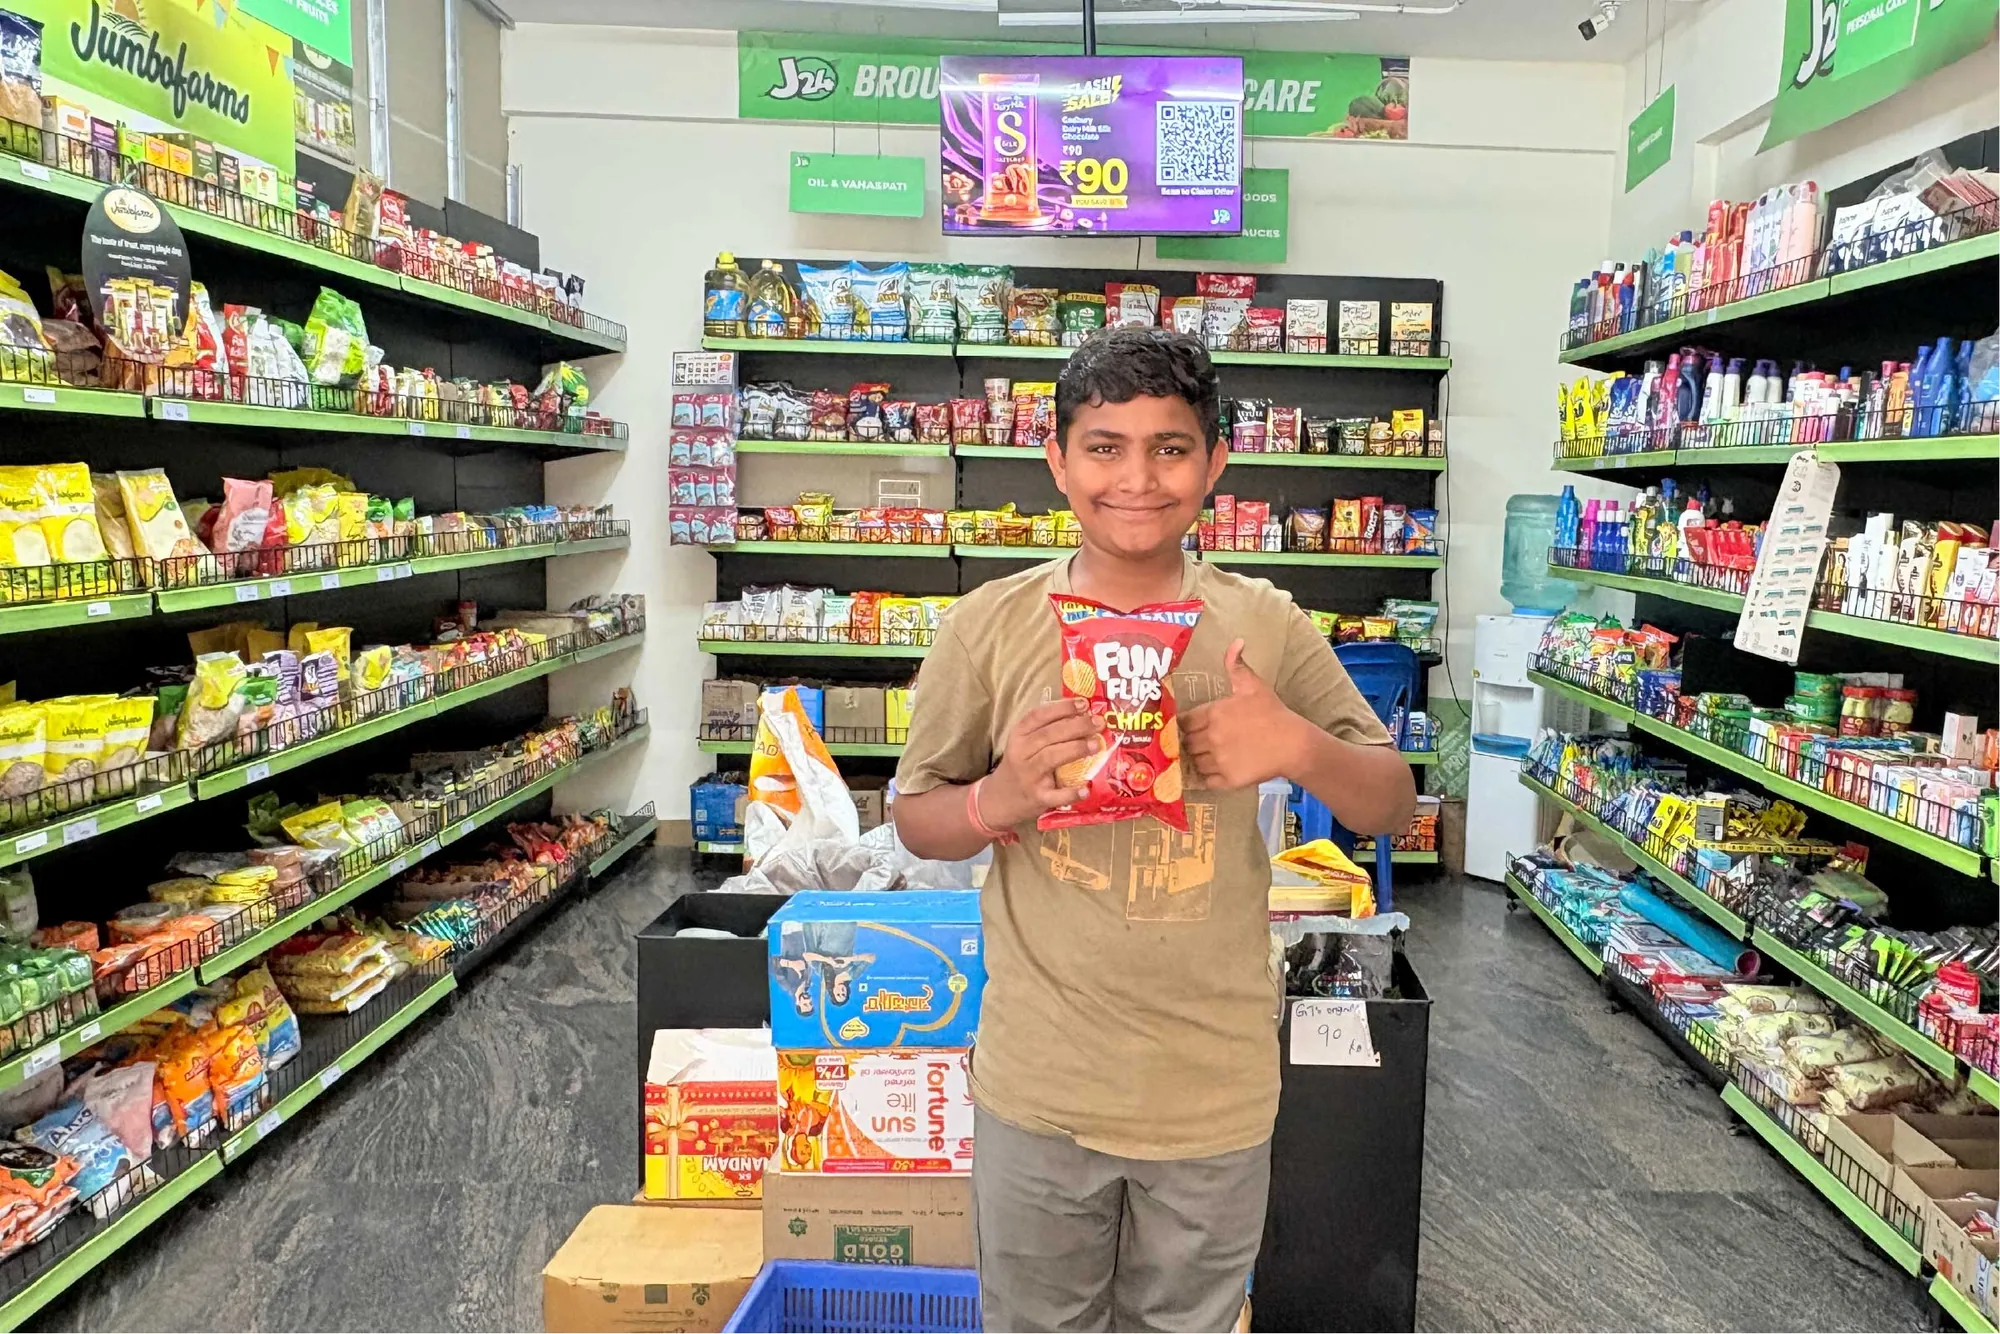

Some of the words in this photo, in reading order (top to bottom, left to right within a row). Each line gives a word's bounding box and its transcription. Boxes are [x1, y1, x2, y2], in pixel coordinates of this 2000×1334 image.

[1846, 3, 1885, 35] PERSONAL
[71, 0, 250, 124] Jumbofarms
[853, 65, 941, 99] BROU
[808, 178, 828, 188] OIL
[831, 178, 839, 188] &
[842, 179, 907, 191] VANASPATI
[1059, 157, 1128, 194] ₹90
[1243, 193, 1277, 203] OODS
[1242, 228, 1280, 238] AUCES
[1093, 641, 1173, 682] FUN
[1104, 711, 1164, 731] CHIPS
[1318, 1024, 1341, 1047] 90
[816, 1065, 846, 1078] 17%
[886, 1092, 916, 1113] lite
[926, 1062, 950, 1152] fortune
[871, 1116, 916, 1133] sun
[703, 1156, 769, 1171] ANDAM
[843, 1244, 904, 1258] GOLD
